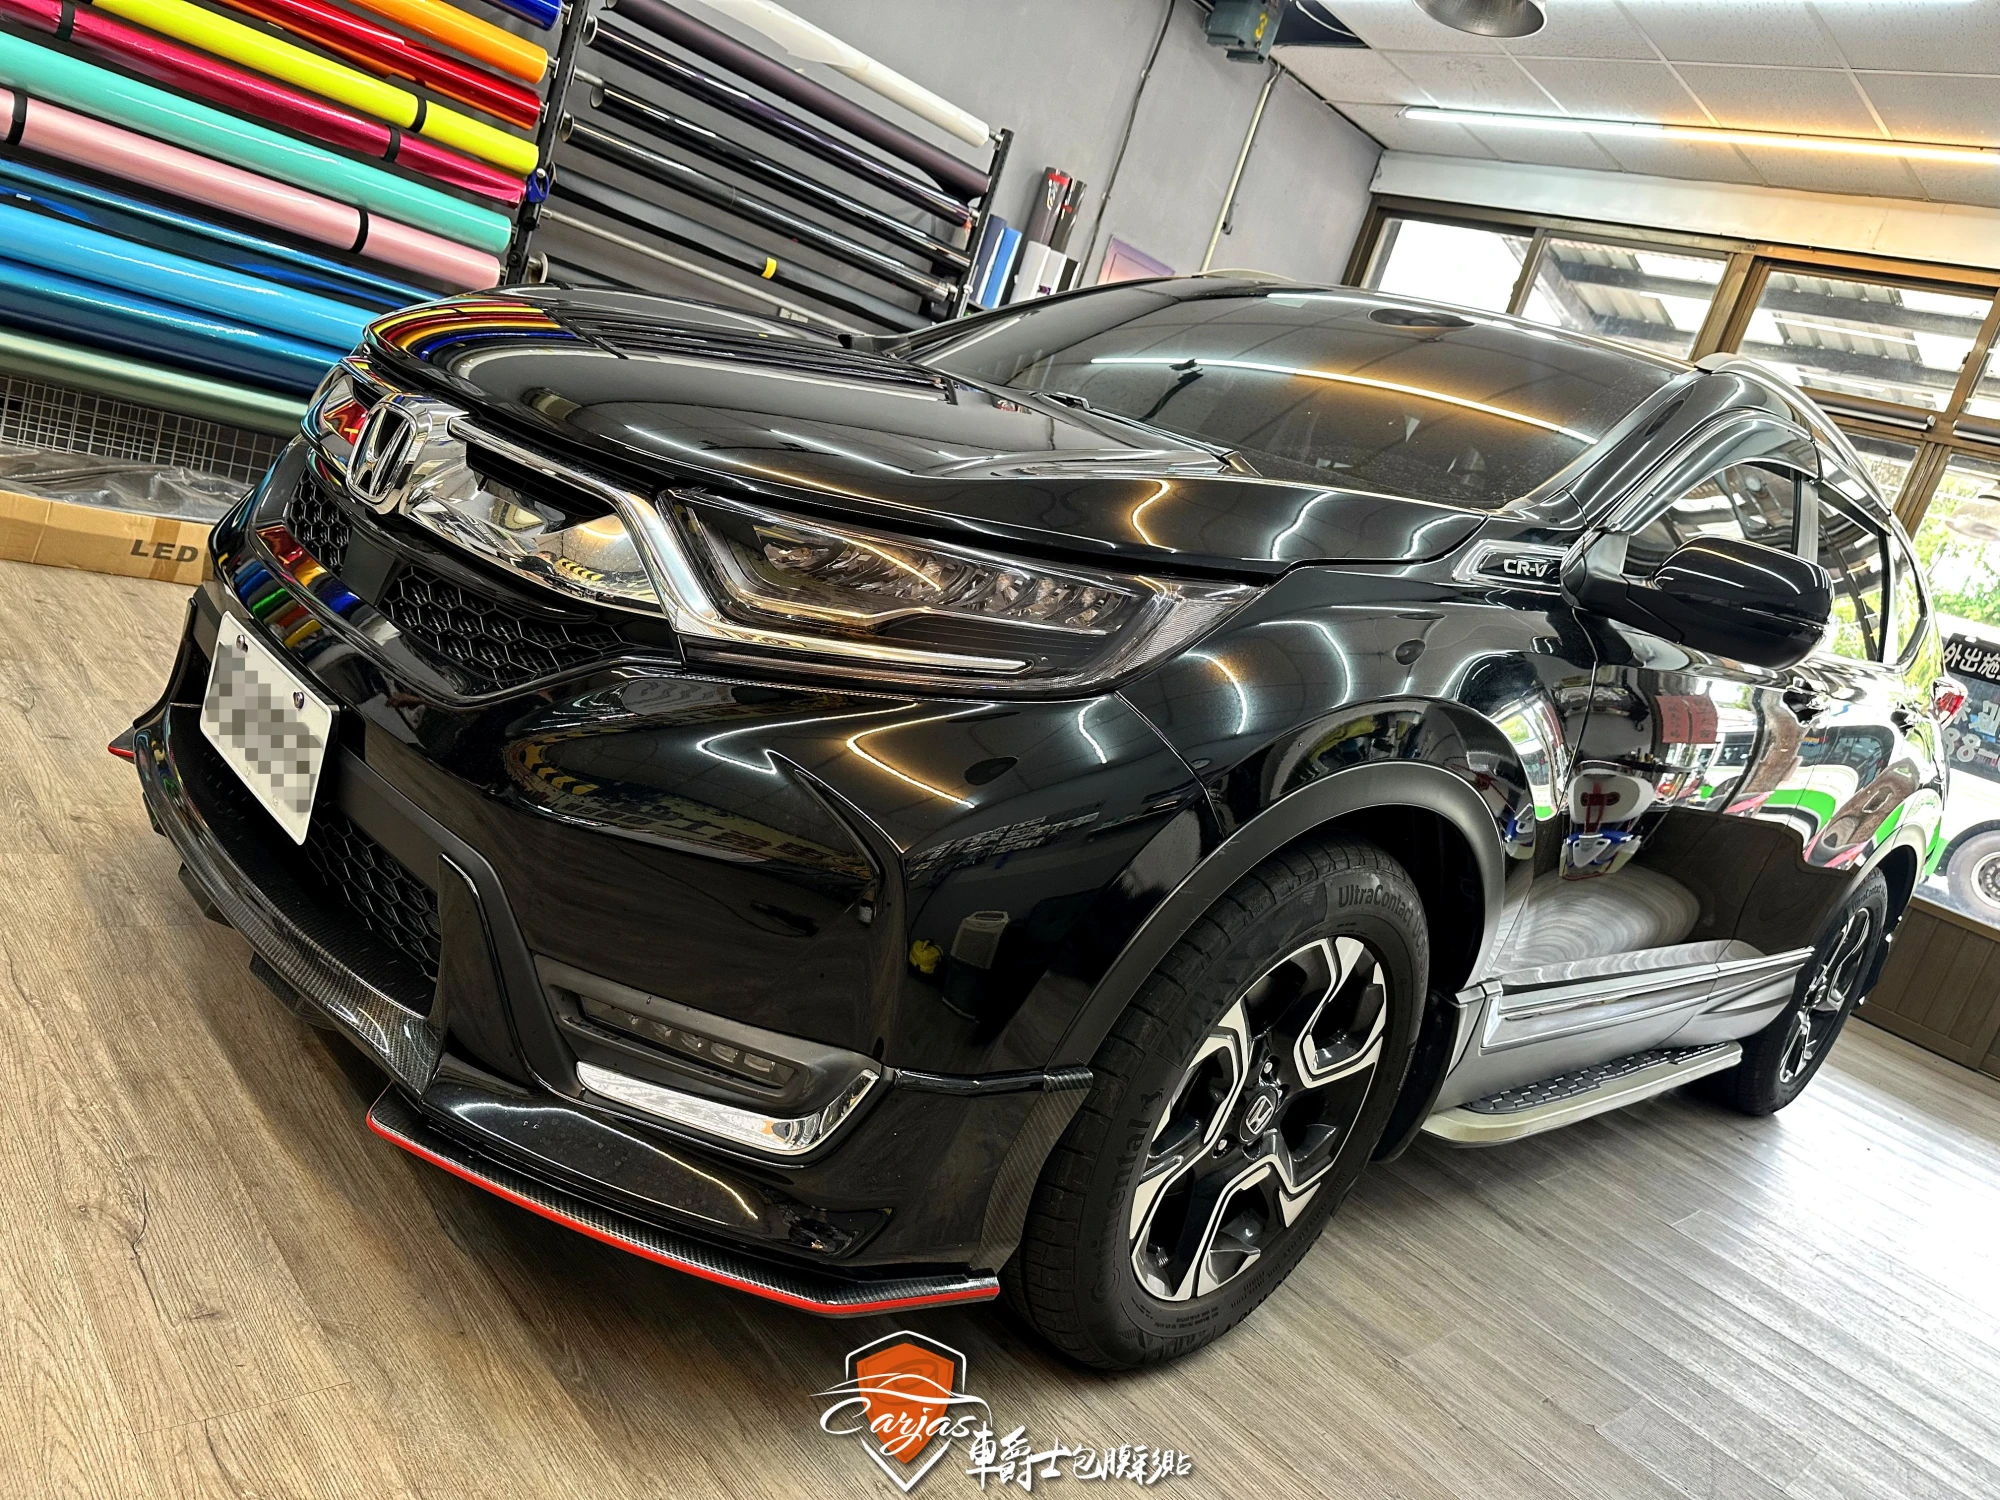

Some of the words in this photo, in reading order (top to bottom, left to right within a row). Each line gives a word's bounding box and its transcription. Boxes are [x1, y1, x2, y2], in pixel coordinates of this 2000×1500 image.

[130, 539, 199, 563] LED
[1503, 558, 1549, 578] CR-V
[1943, 641, 2000, 681] 外出施
[1339, 884, 1414, 928] UltraContact
